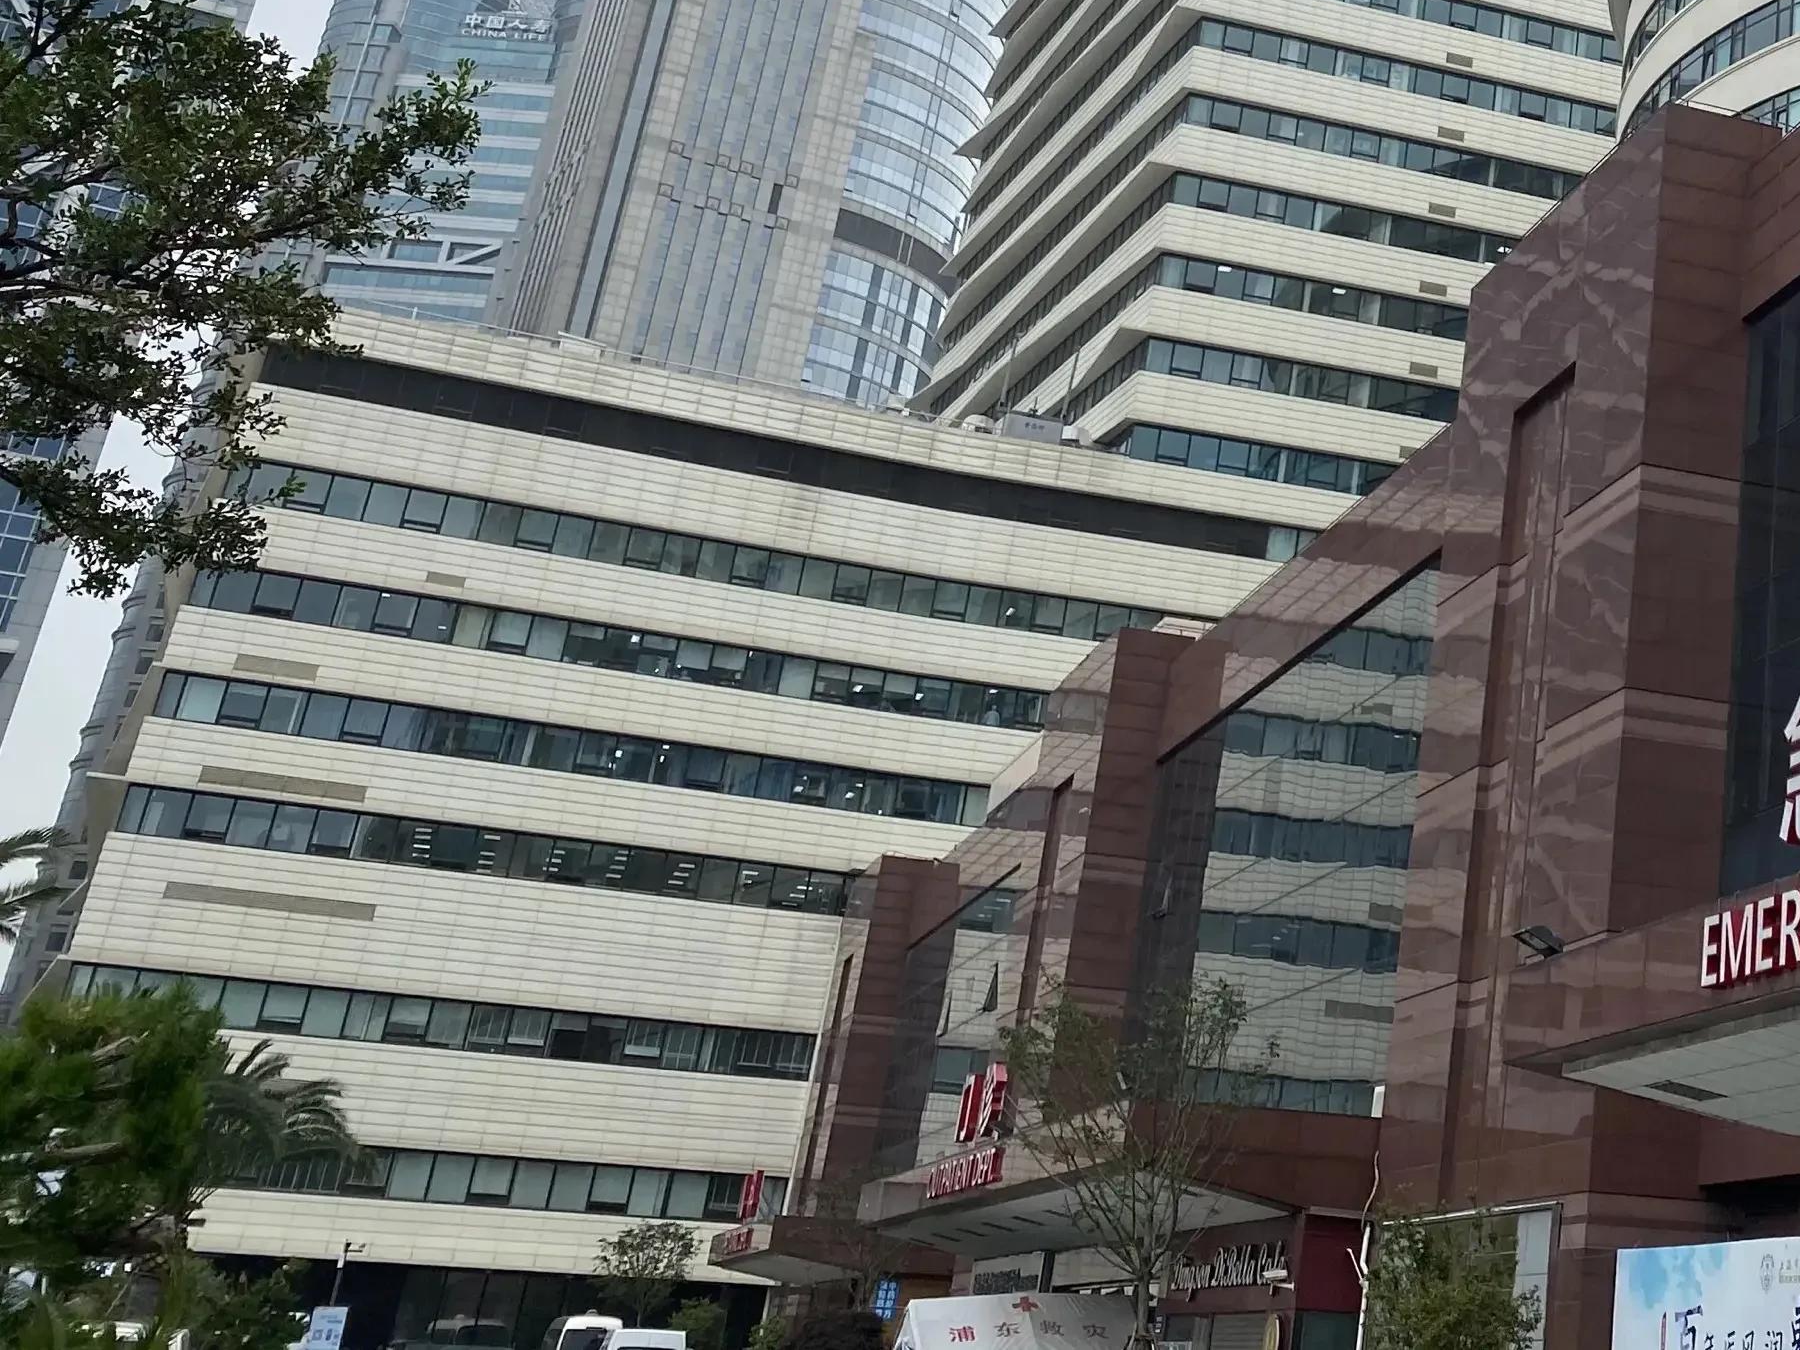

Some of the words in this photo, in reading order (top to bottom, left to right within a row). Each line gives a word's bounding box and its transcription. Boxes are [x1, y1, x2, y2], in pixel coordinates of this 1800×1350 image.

[465, 13, 551, 33] 中国人寿
[461, 28, 507, 38] CHINA
[514, 32, 546, 41] LIFE
[949, 1320, 1109, 1342] 浦东救灾
